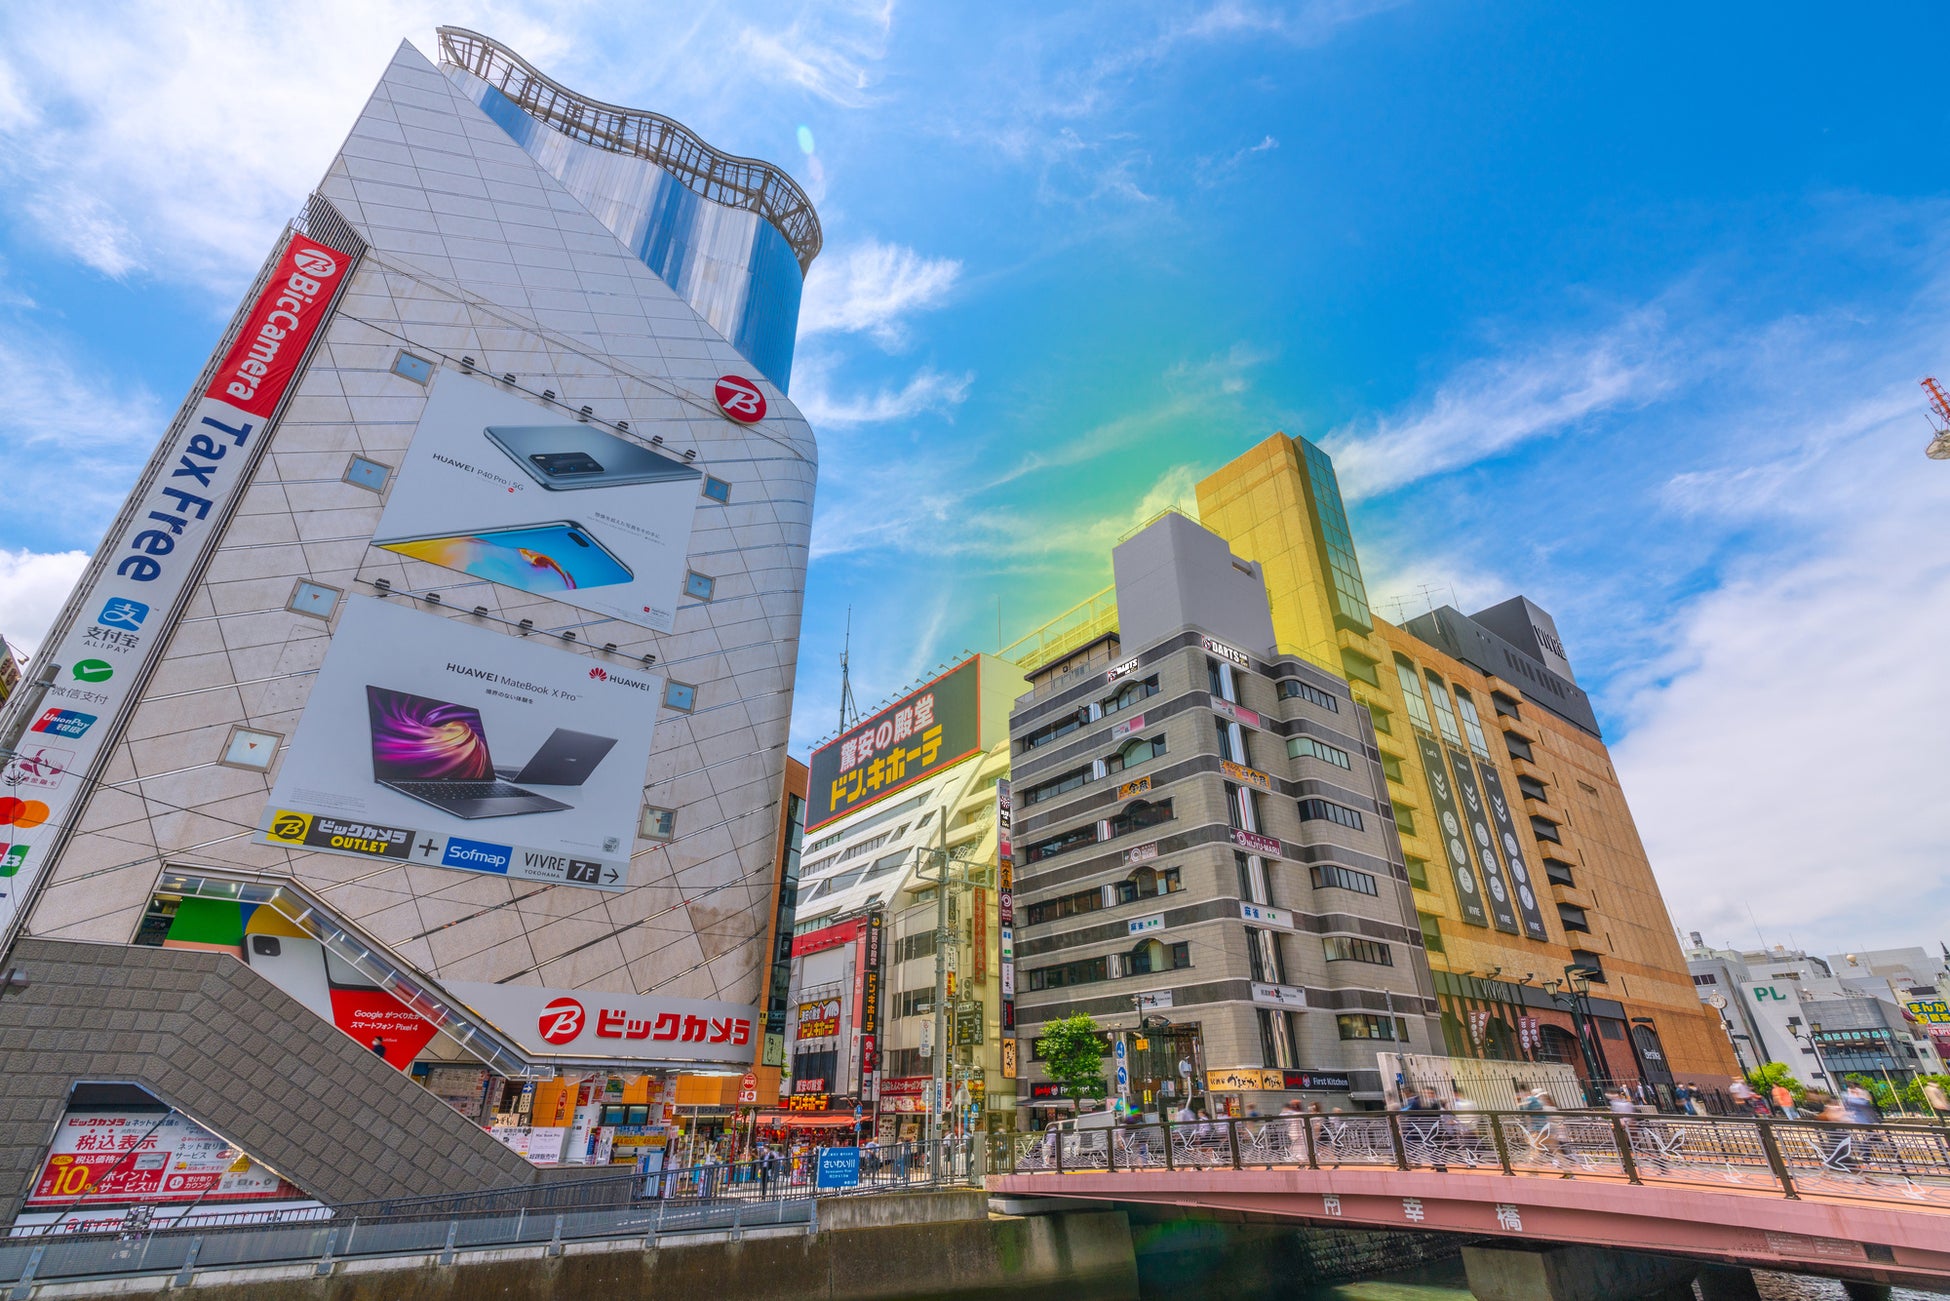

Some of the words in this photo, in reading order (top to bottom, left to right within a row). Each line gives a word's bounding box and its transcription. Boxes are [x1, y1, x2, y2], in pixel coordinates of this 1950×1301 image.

[227, 273, 321, 401] BicCamera
[173, 416, 253, 488] Tax
[432, 453, 475, 473] HUAWEI
[477, 469, 493, 480] P40
[494, 475, 507, 485] Pro
[513, 482, 524, 491] 5G
[117, 486, 214, 582] Free
[82, 625, 140, 648] 支付宝
[1533, 624, 1567, 661] VIVRE
[83, 640, 129, 654] ALIPAY
[1212, 641, 1239, 663] DARTS
[446, 663, 499, 683] HUAWEI
[500, 676, 549, 695] MateBook
[552, 689, 559, 697] X
[561, 691, 576, 701] Pro
[609, 675, 650, 691] HUAWEI
[51, 686, 110, 705] 微信支付
[43, 713, 91, 728] UnionPay
[840, 693, 934, 772] 驚安の殿堂
[317, 819, 408, 844] ビックカメラ
[330, 836, 389, 853] OUTLET
[448, 846, 506, 868] Sofmap
[524, 869, 561, 879] YOKOHAMA
[525, 852, 567, 871] VIVRE
[573, 863, 595, 881] 7F
[1244, 906, 1259, 918] 麻雀
[1468, 905, 1481, 917] VIVRE
[1500, 914, 1511, 925] VIVRE
[1529, 921, 1540, 932] VIVRE
[1753, 986, 1786, 1001] PL
[354, 1009, 383, 1019] Google
[1909, 1003, 1947, 1013] まんが
[350, 1021, 394, 1030] スマートフォン
[395, 1023, 412, 1031] Pixel
[595, 1008, 751, 1046] ビックカメラ
[1313, 1077, 1327, 1085] First
[1327, 1078, 1348, 1086] Kitchen
[75, 1134, 158, 1150] 税込表示
[175, 1151, 207, 1159] サービス
[103, 1170, 151, 1181] ポイント
